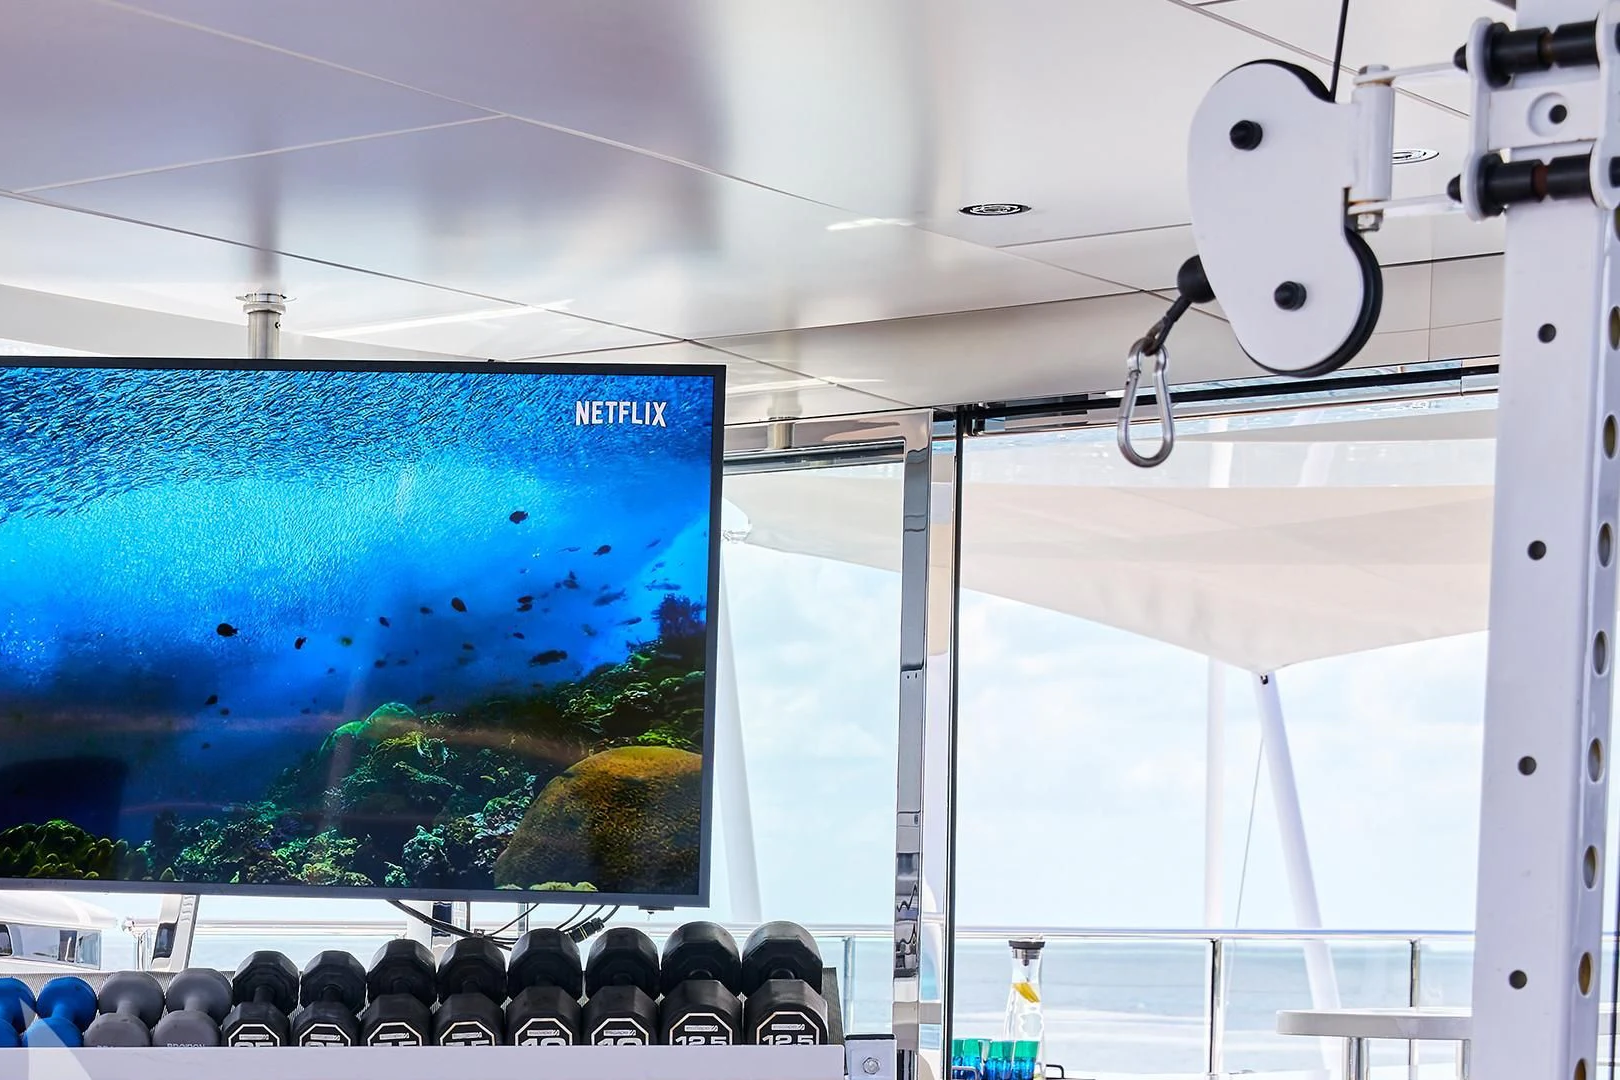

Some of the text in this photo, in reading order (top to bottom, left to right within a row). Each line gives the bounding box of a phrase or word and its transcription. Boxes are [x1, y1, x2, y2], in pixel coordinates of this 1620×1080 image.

[575, 400, 667, 427] NETFLIX
[675, 1035, 728, 1045] 125
[762, 1034, 814, 1045] 125
